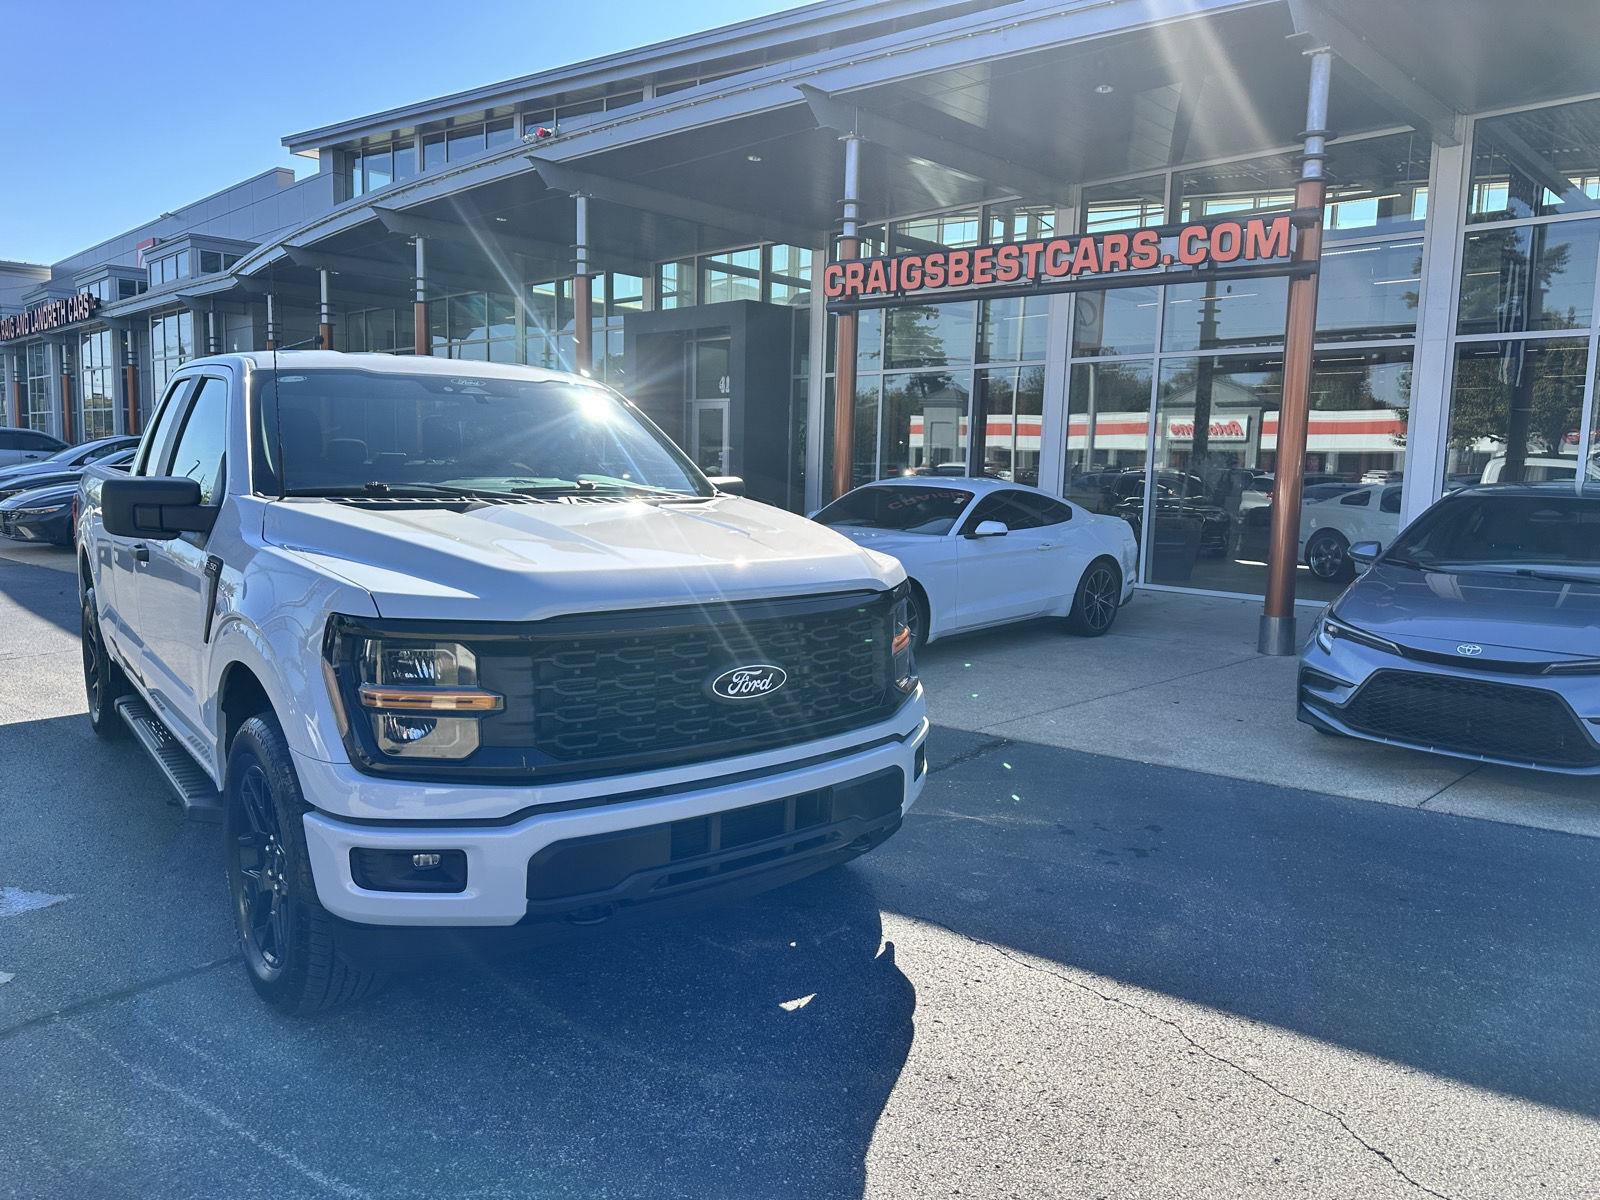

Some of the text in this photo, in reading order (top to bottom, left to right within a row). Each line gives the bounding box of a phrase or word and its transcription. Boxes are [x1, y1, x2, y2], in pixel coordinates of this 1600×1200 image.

[823, 217, 1291, 297] CRAIGSBESTCARS.COM
[0, 317, 14, 340] RAIG
[16, 312, 29, 337] AND
[31, 300, 66, 332] LANDRETH
[68, 292, 88, 322] CARS
[727, 669, 773, 695] Ford
